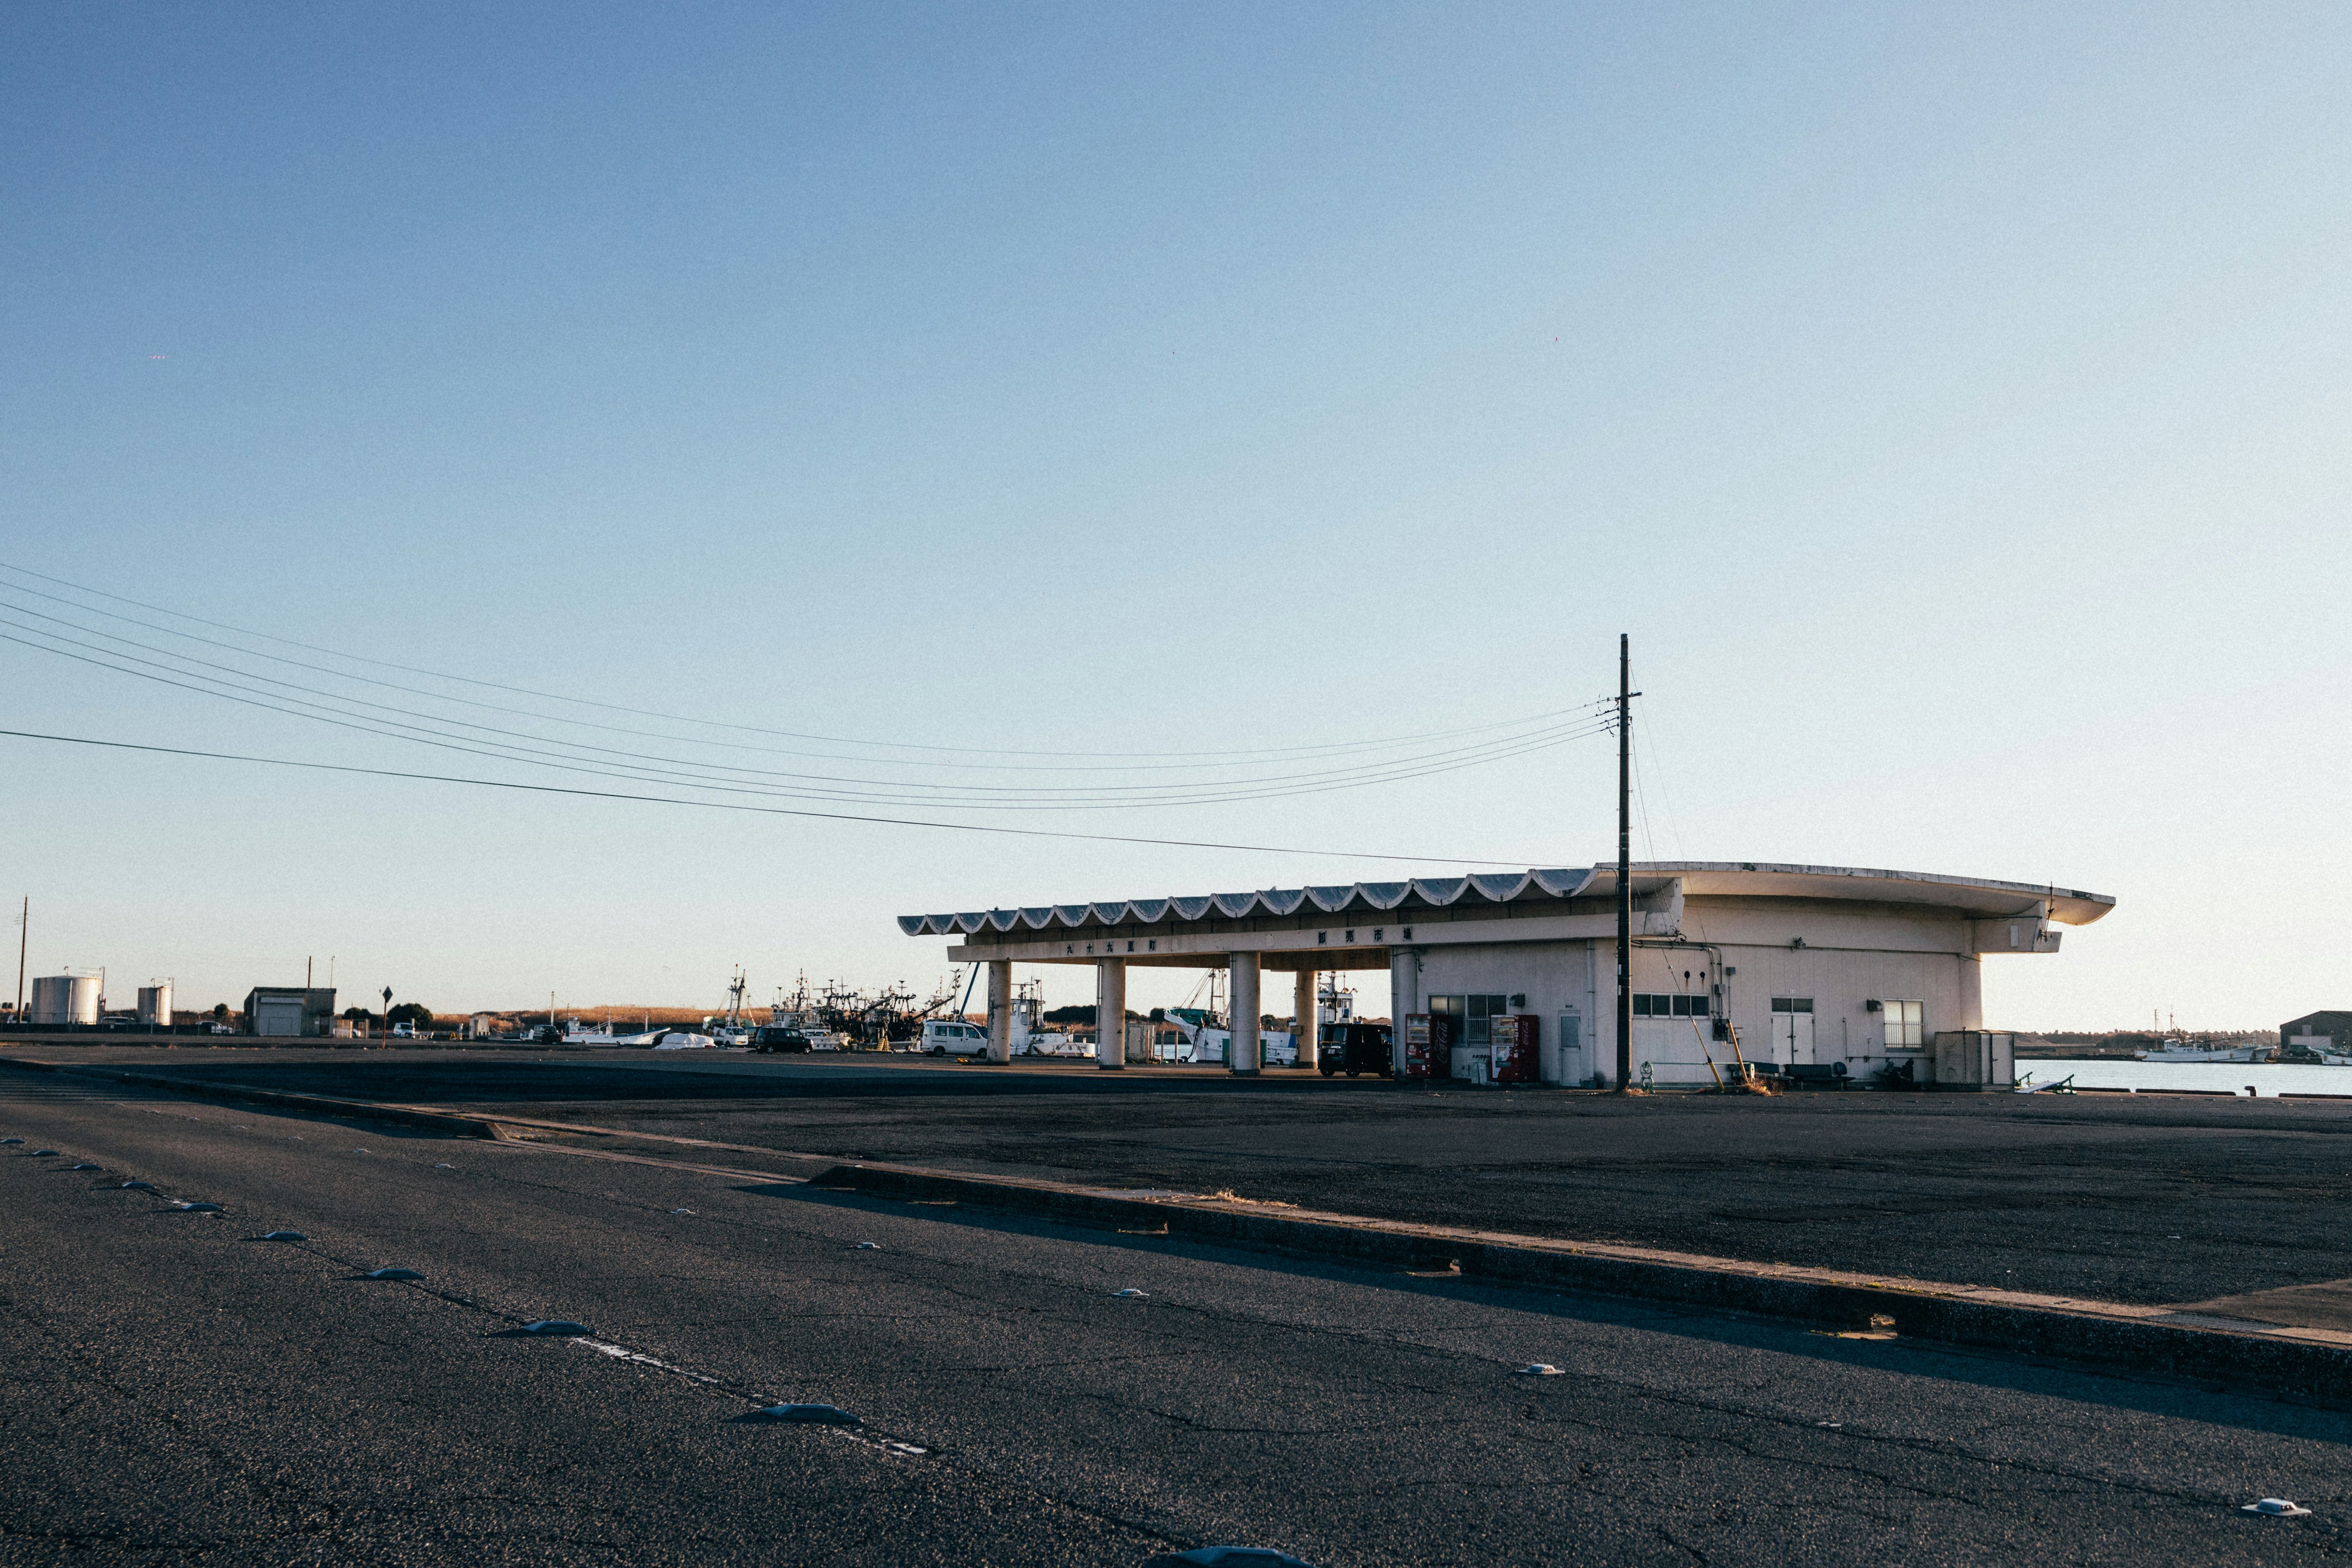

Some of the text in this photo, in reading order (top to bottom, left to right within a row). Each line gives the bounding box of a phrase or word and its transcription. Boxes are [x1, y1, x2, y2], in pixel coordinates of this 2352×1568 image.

[1067, 928, 1412, 954] 九十九里町 卸売市場
